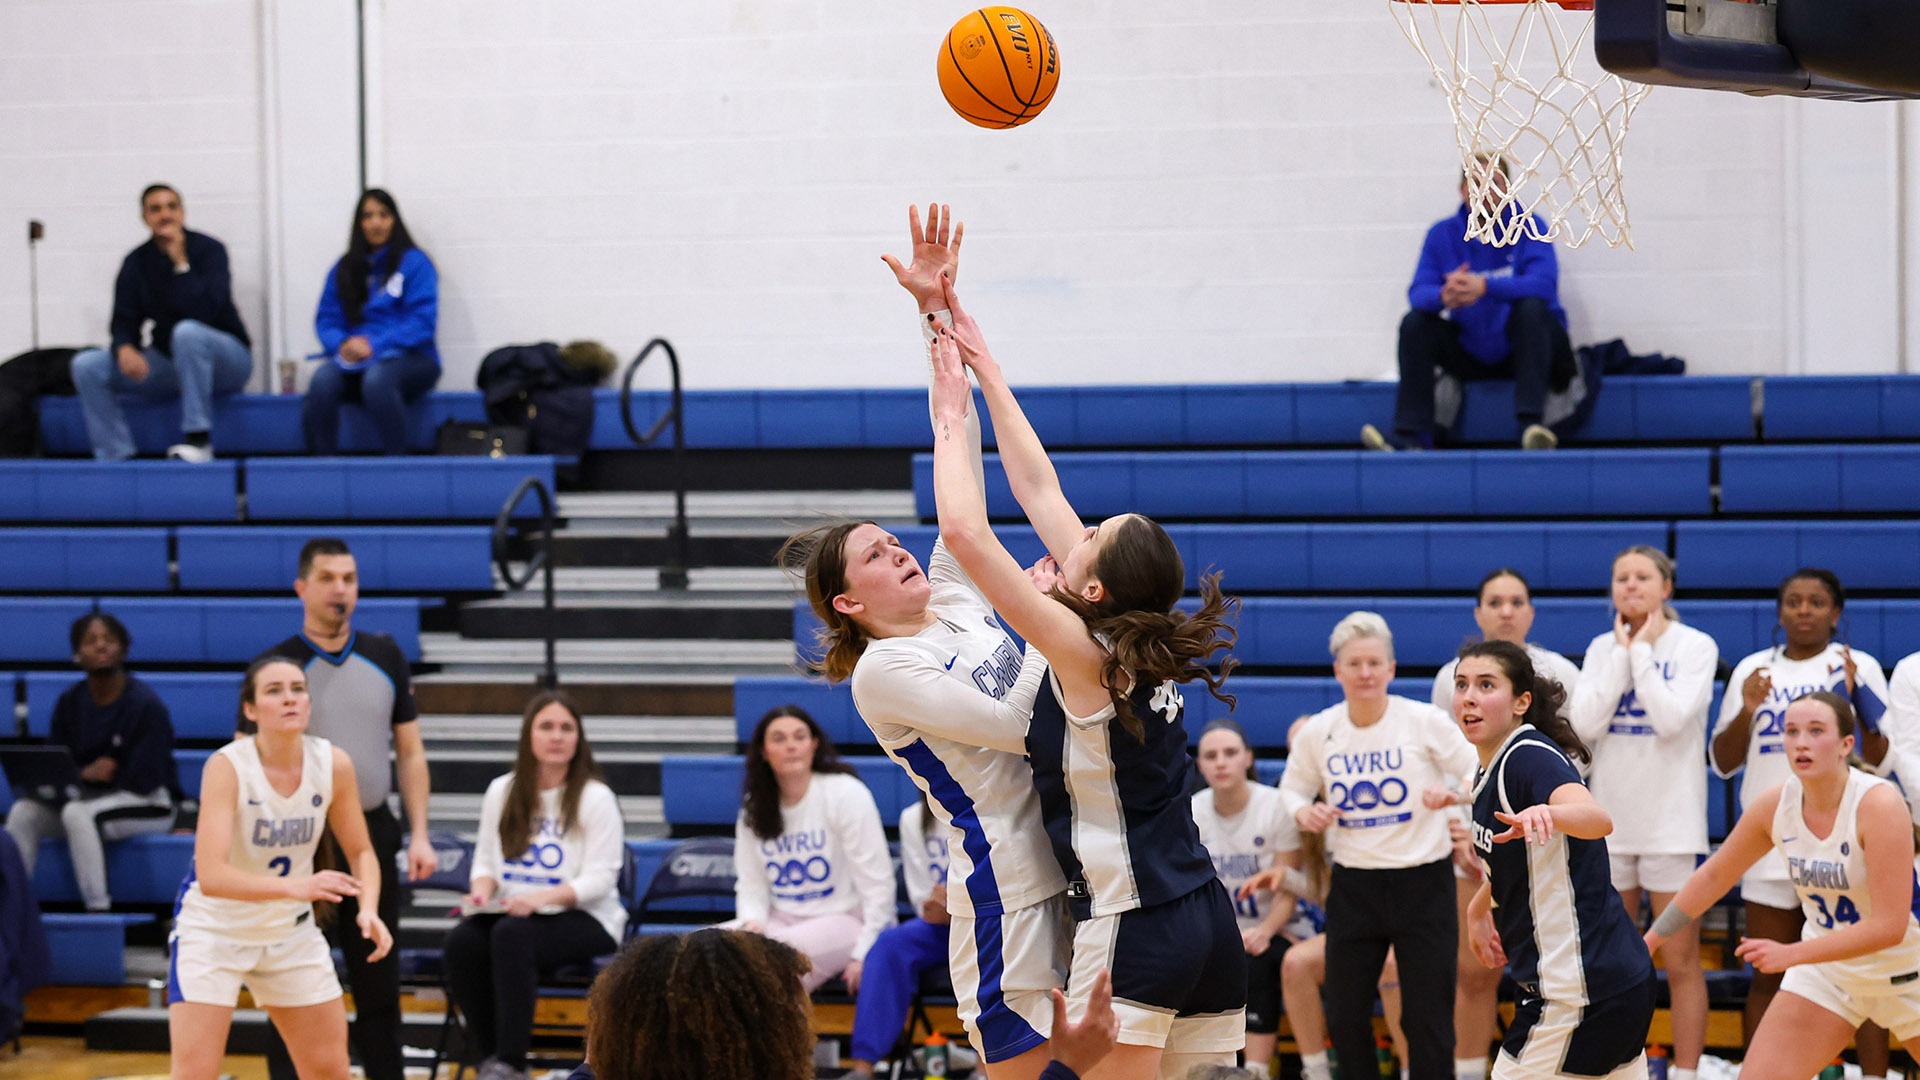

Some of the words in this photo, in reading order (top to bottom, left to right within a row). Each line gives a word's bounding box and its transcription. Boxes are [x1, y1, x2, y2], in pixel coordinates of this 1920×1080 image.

[1000, 13, 1031, 53] EVO
[1327, 747, 1402, 776] CWRU
[1330, 777, 1408, 812] 200
[252, 817, 314, 848] CWRU
[766, 855, 830, 888] 200
[1788, 856, 1850, 890] CWRU
[1807, 893, 1862, 930] 34
